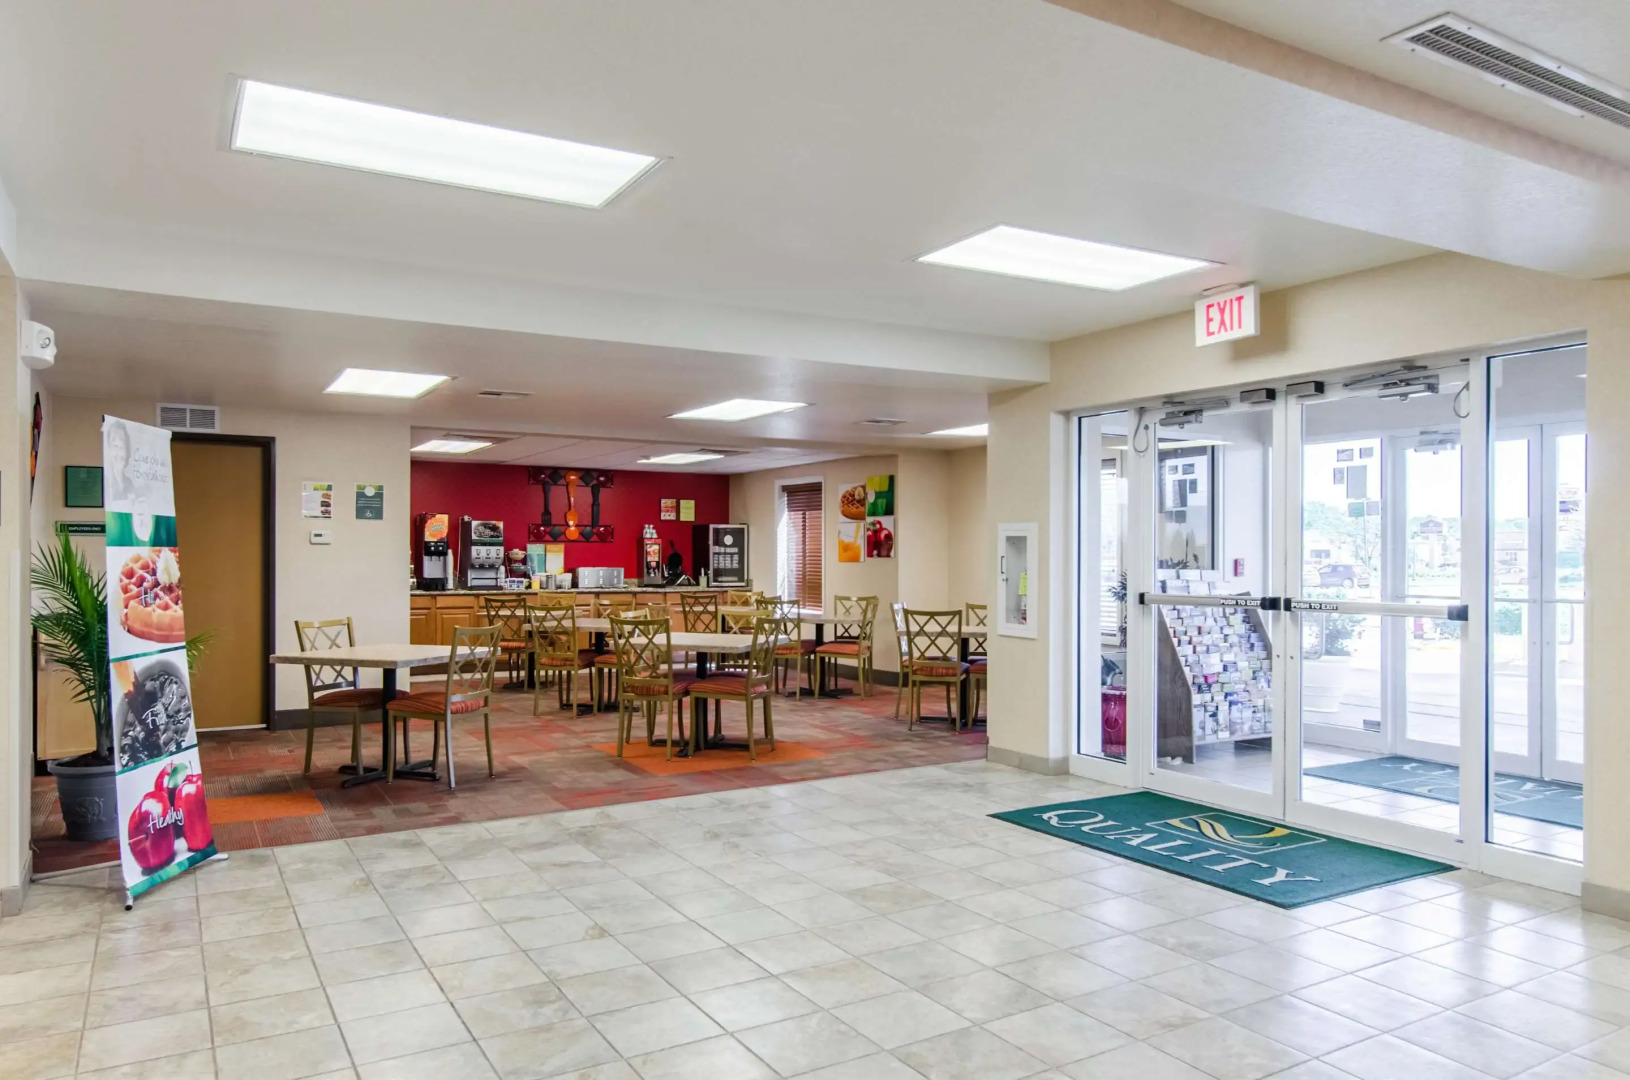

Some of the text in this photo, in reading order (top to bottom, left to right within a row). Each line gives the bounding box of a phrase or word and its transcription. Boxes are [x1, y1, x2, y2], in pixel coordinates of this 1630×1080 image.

[1205, 295, 1244, 337] EXIT
[147, 806, 185, 834] Healthy
[1032, 809, 1323, 887] QUALITY
